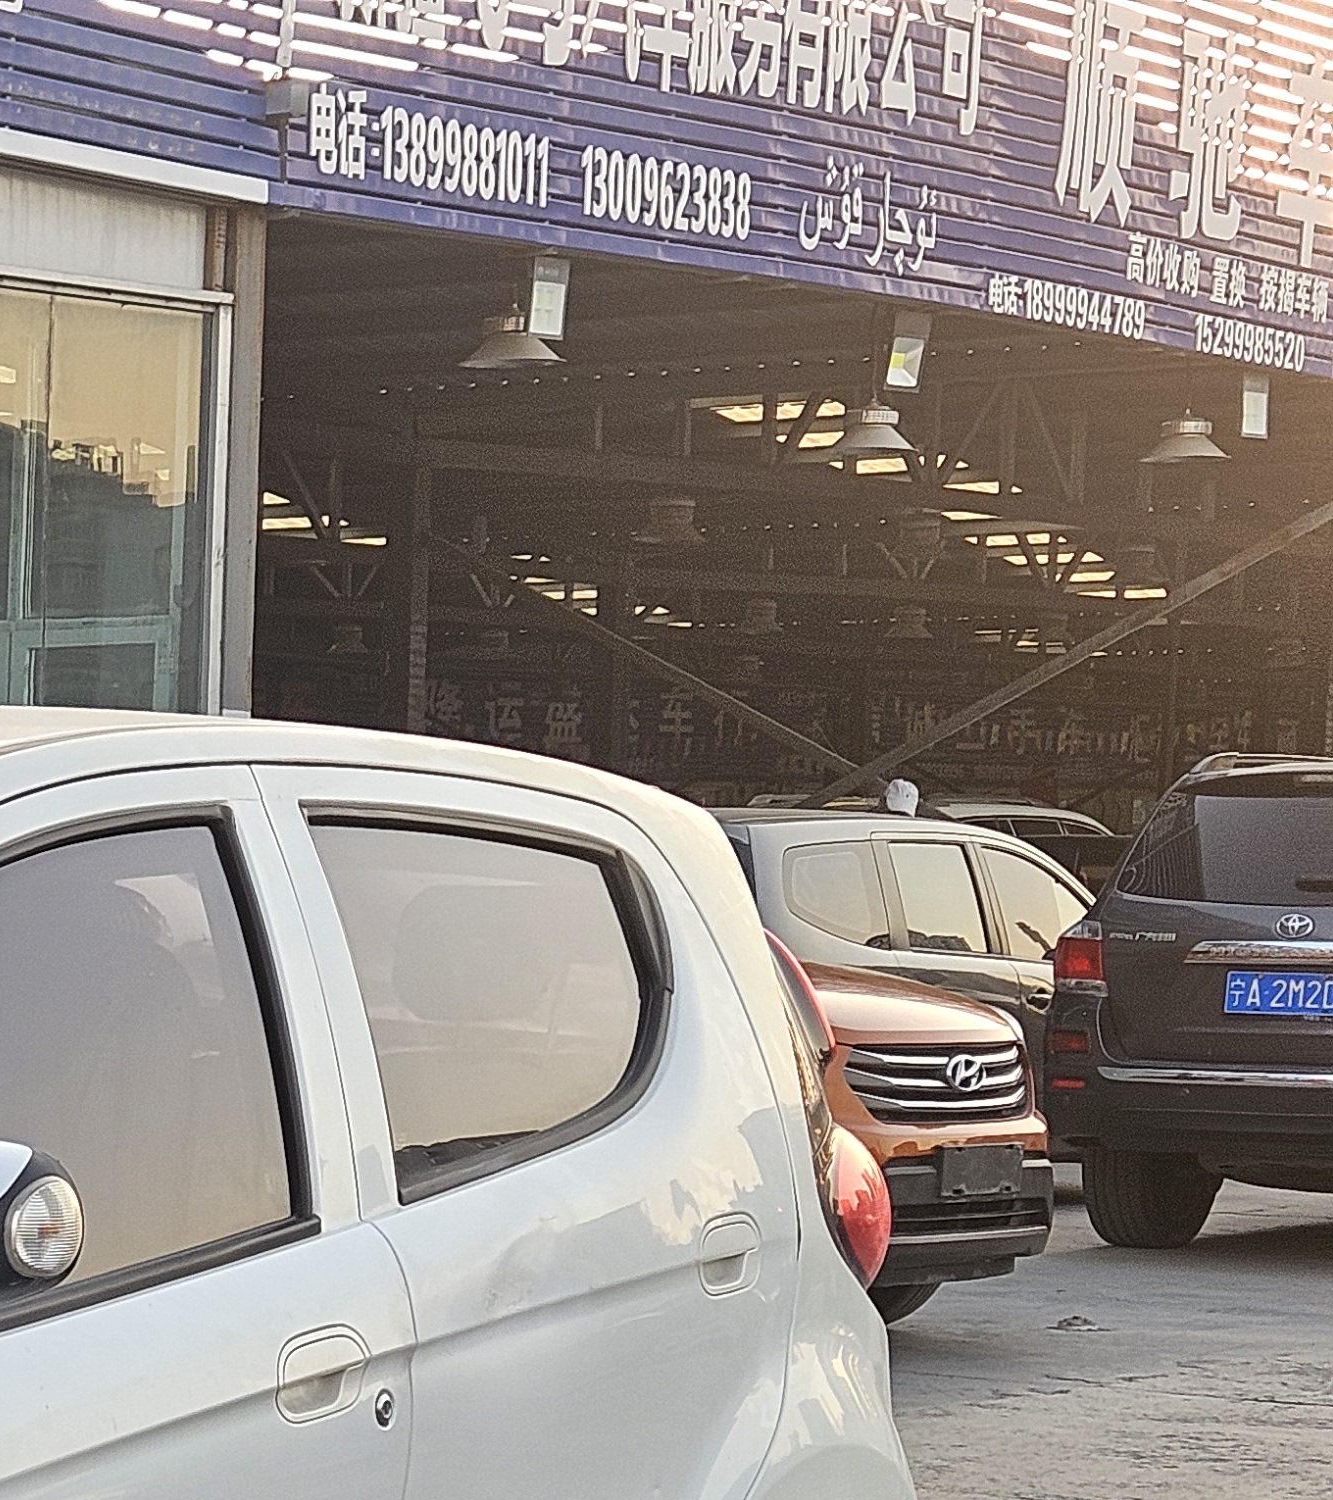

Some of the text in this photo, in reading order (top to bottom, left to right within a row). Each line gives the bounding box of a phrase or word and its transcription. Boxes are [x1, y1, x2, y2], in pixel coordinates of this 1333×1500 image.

[581, 144, 752, 241] 13009623838
[1126, 231, 1201, 298] 高价收购
[1209, 256, 1247, 309] 置换
[1194, 314, 1306, 372] 15299985520
